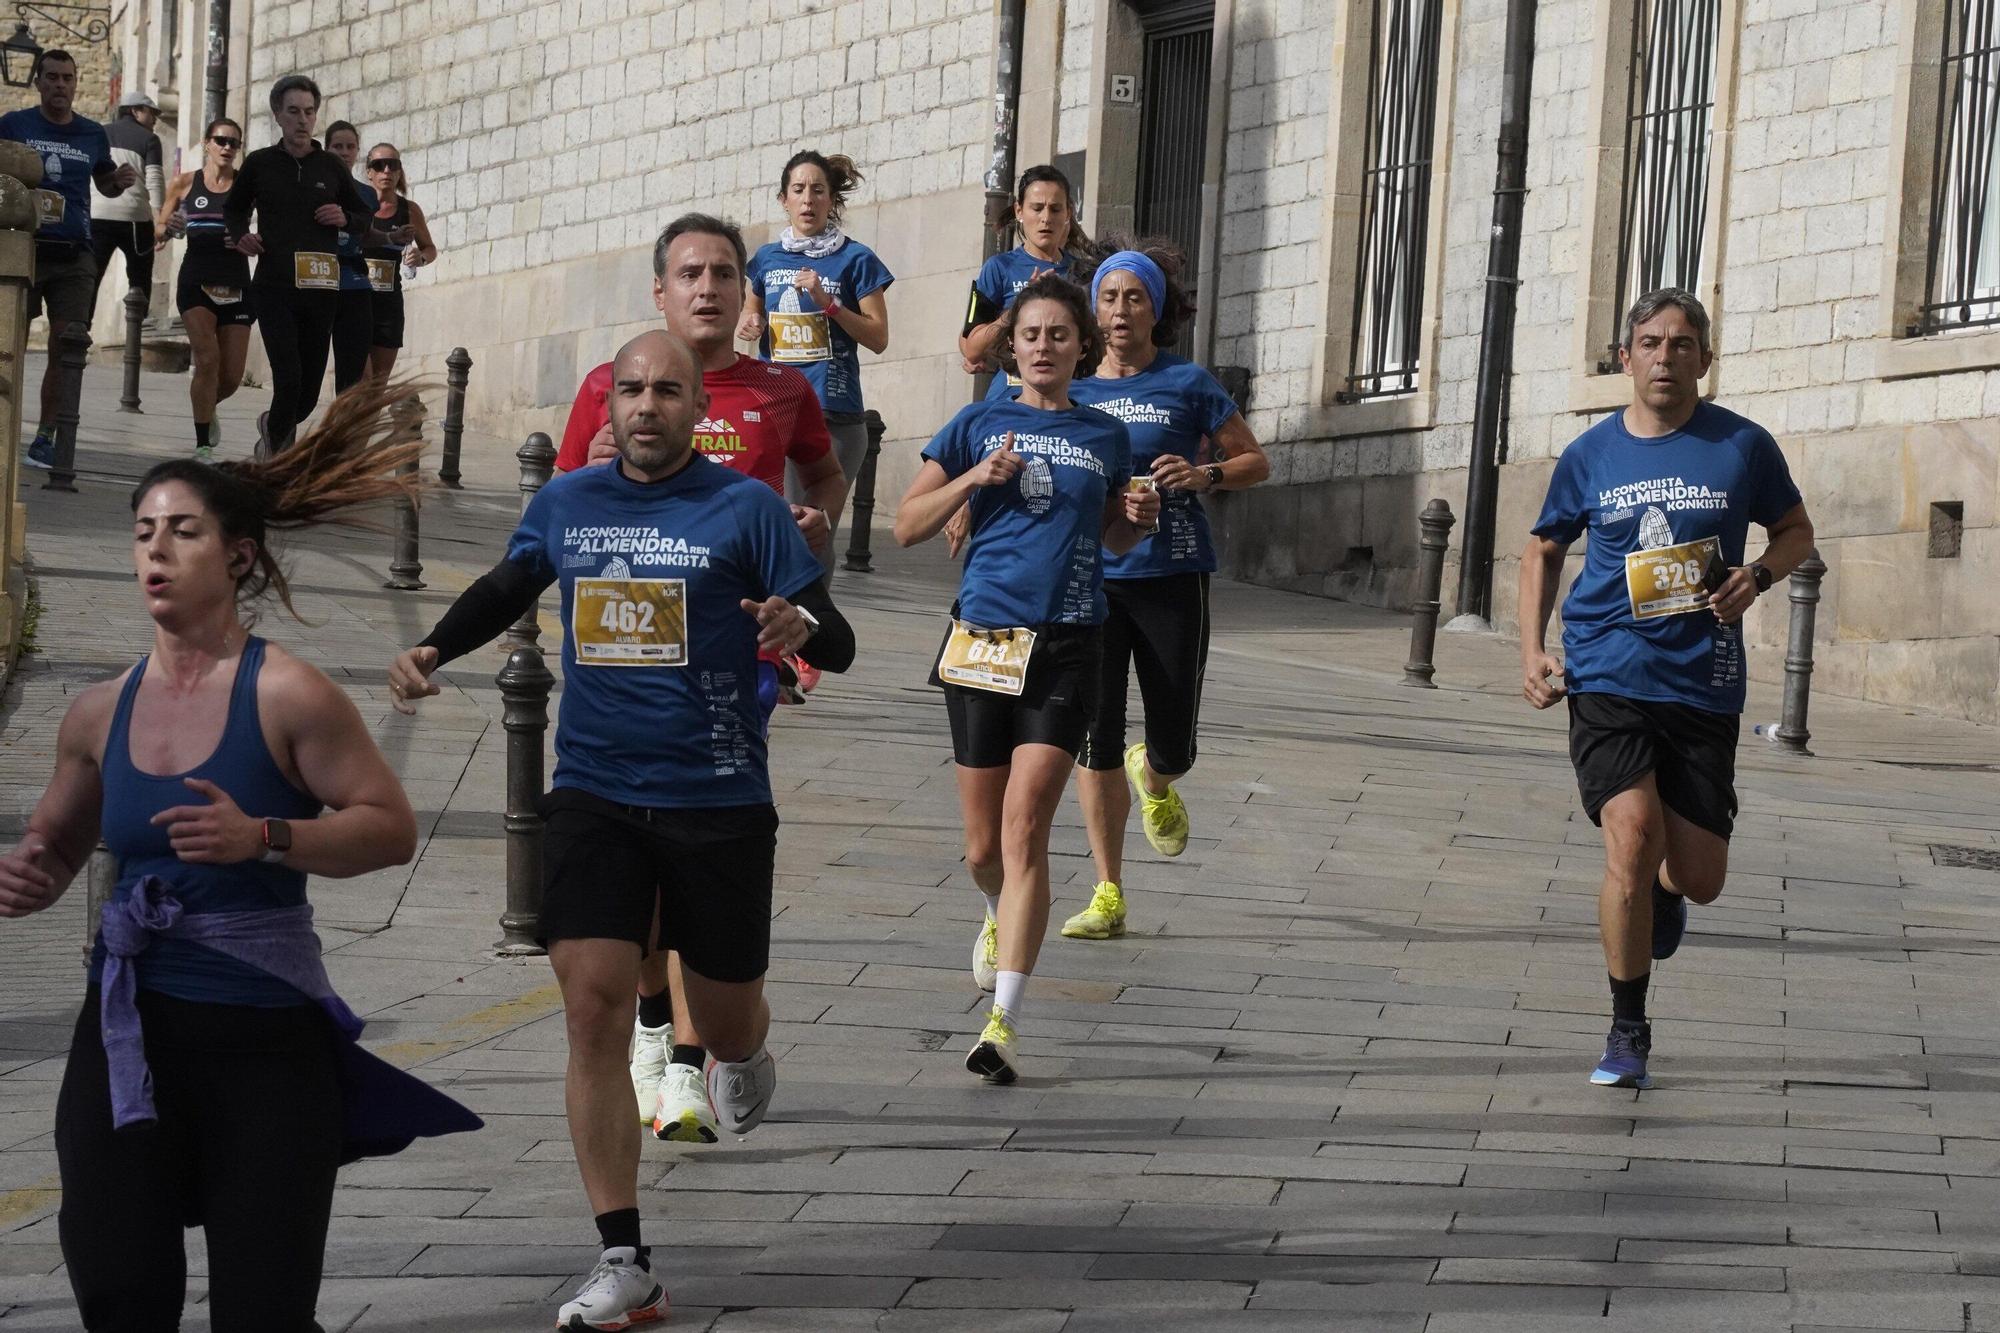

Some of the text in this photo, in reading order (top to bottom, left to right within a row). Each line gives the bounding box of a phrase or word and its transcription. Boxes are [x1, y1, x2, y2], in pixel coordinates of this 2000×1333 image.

[1116, 79, 1130, 98] 5
[310, 261, 331, 276] 315
[781, 325, 813, 344] 430
[999, 433, 1070, 446] CNQUISTA
[1010, 441, 1094, 462] LMENDRA
[1599, 477, 1684, 501] LA CONQUISTA
[1615, 485, 1712, 510] ALMENDRA
[1712, 491, 1727, 499] REN
[1666, 499, 1729, 512] KONKISTA
[565, 527, 660, 539] LA CONQUISTA
[578, 537, 688, 554] ALMENDRA
[689, 545, 710, 556] REN
[633, 553, 710, 569] KONKISTA
[1653, 559, 1701, 591] 326
[662, 586, 679, 597] 10K
[1669, 588, 1692, 598] SERGIO
[600, 601, 655, 633] 462
[615, 635, 641, 644] ALVARO
